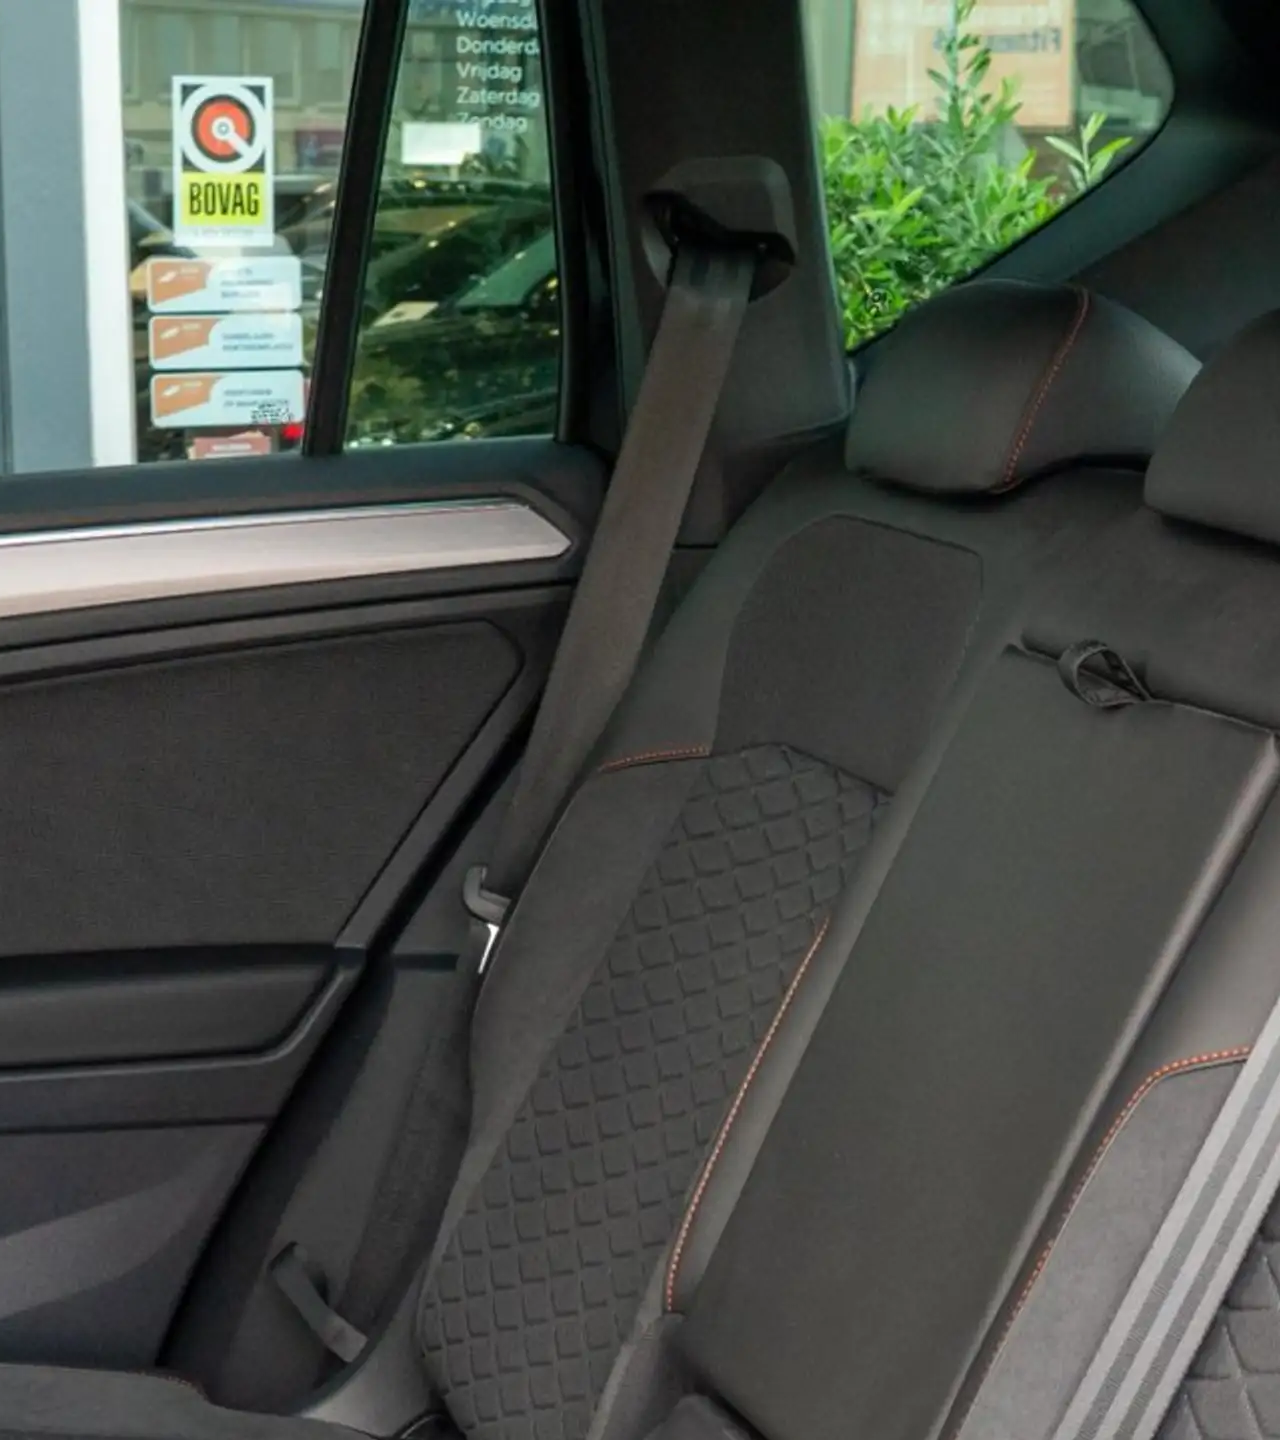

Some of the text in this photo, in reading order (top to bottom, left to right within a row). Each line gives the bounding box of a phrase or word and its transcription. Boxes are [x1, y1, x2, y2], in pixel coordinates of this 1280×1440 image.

[456, 10, 537, 29] Woensd
[456, 36, 540, 55] Donderd
[456, 62, 522, 83] Vrijdag
[456, 86, 540, 108] Zaterdag
[188, 182, 261, 217] BOVAG
